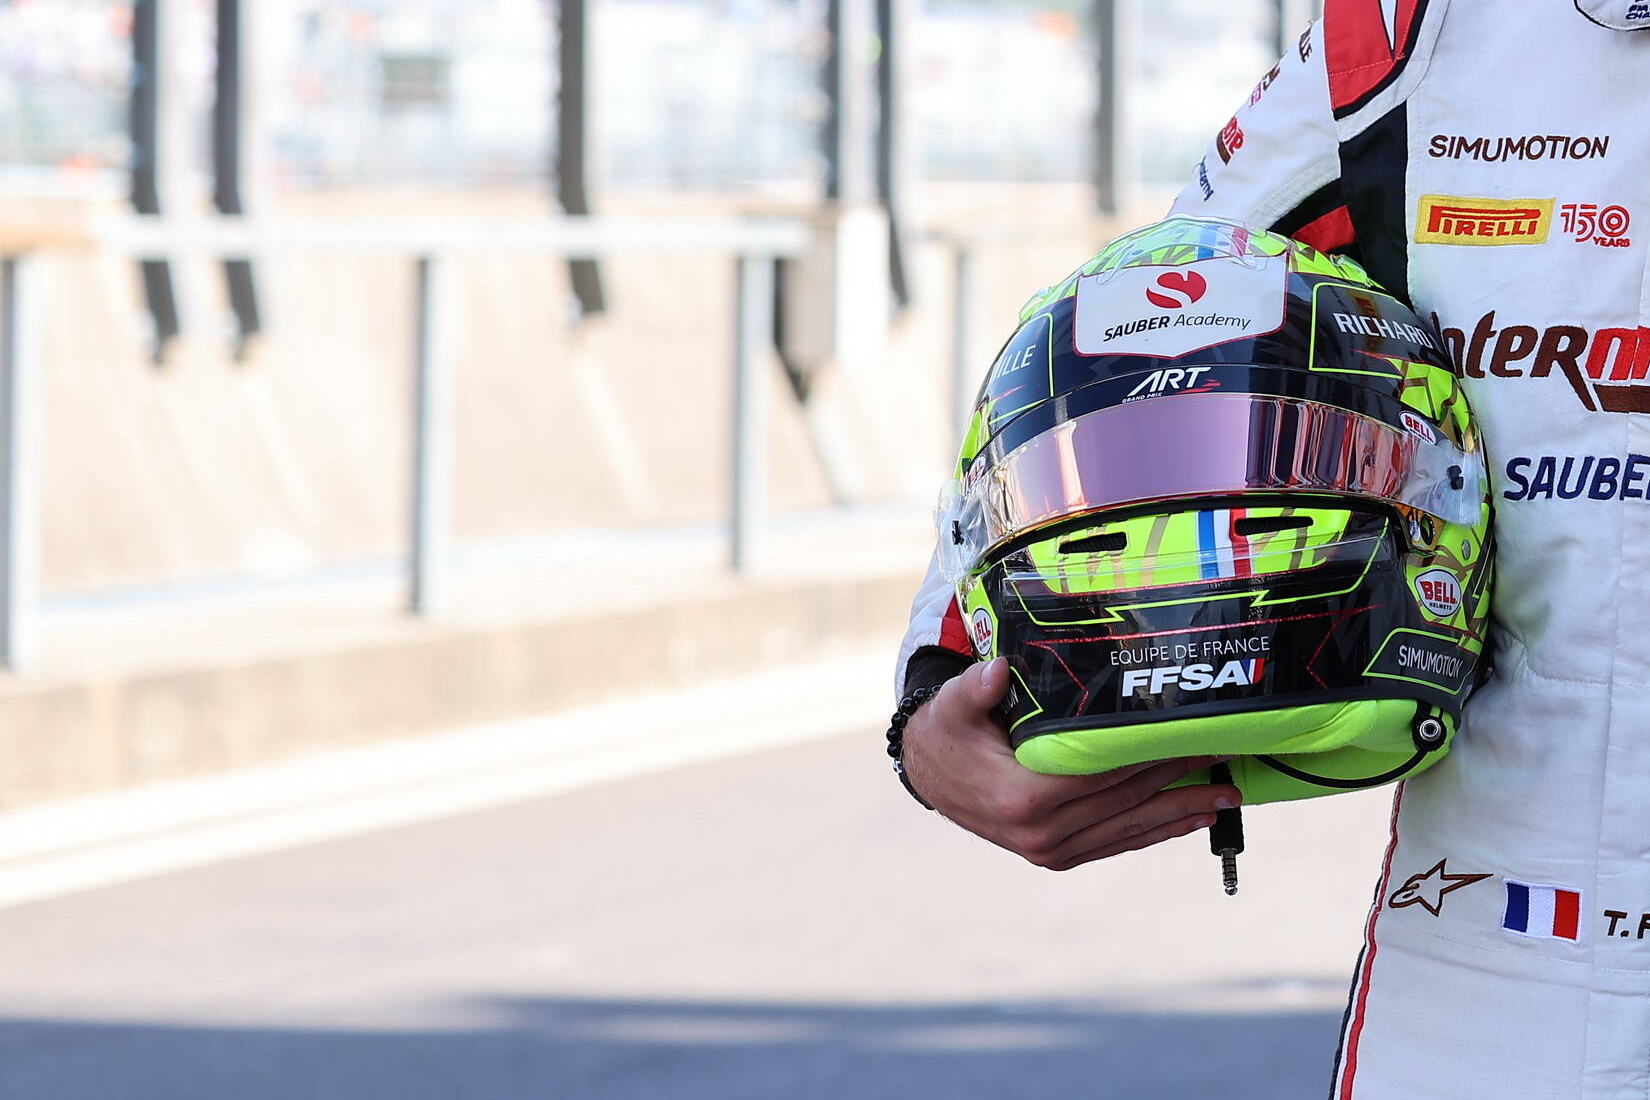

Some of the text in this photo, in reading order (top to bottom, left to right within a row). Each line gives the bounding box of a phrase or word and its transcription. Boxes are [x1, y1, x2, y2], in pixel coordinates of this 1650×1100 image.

[1428, 134, 1610, 163] SIMUMOTION
[1427, 204, 1541, 237] PIRELLI
[1560, 203, 1630, 243] 150
[1593, 236, 1631, 248] YEARS
[1103, 312, 1252, 342] SAUBER Academy
[1332, 312, 1434, 350] RICHARD
[1127, 366, 1212, 397] ART
[1122, 393, 1145, 404] GRAND
[1405, 414, 1435, 444] BELL
[1420, 581, 1458, 605] BELL
[1429, 602, 1452, 611] HELMETS
[1110, 635, 1271, 666] EQUIPE DE FRANCE
[1398, 644, 1463, 678] SIMUMOTION
[1122, 659, 1250, 697] FFSA
[1603, 909, 1629, 939] T.
